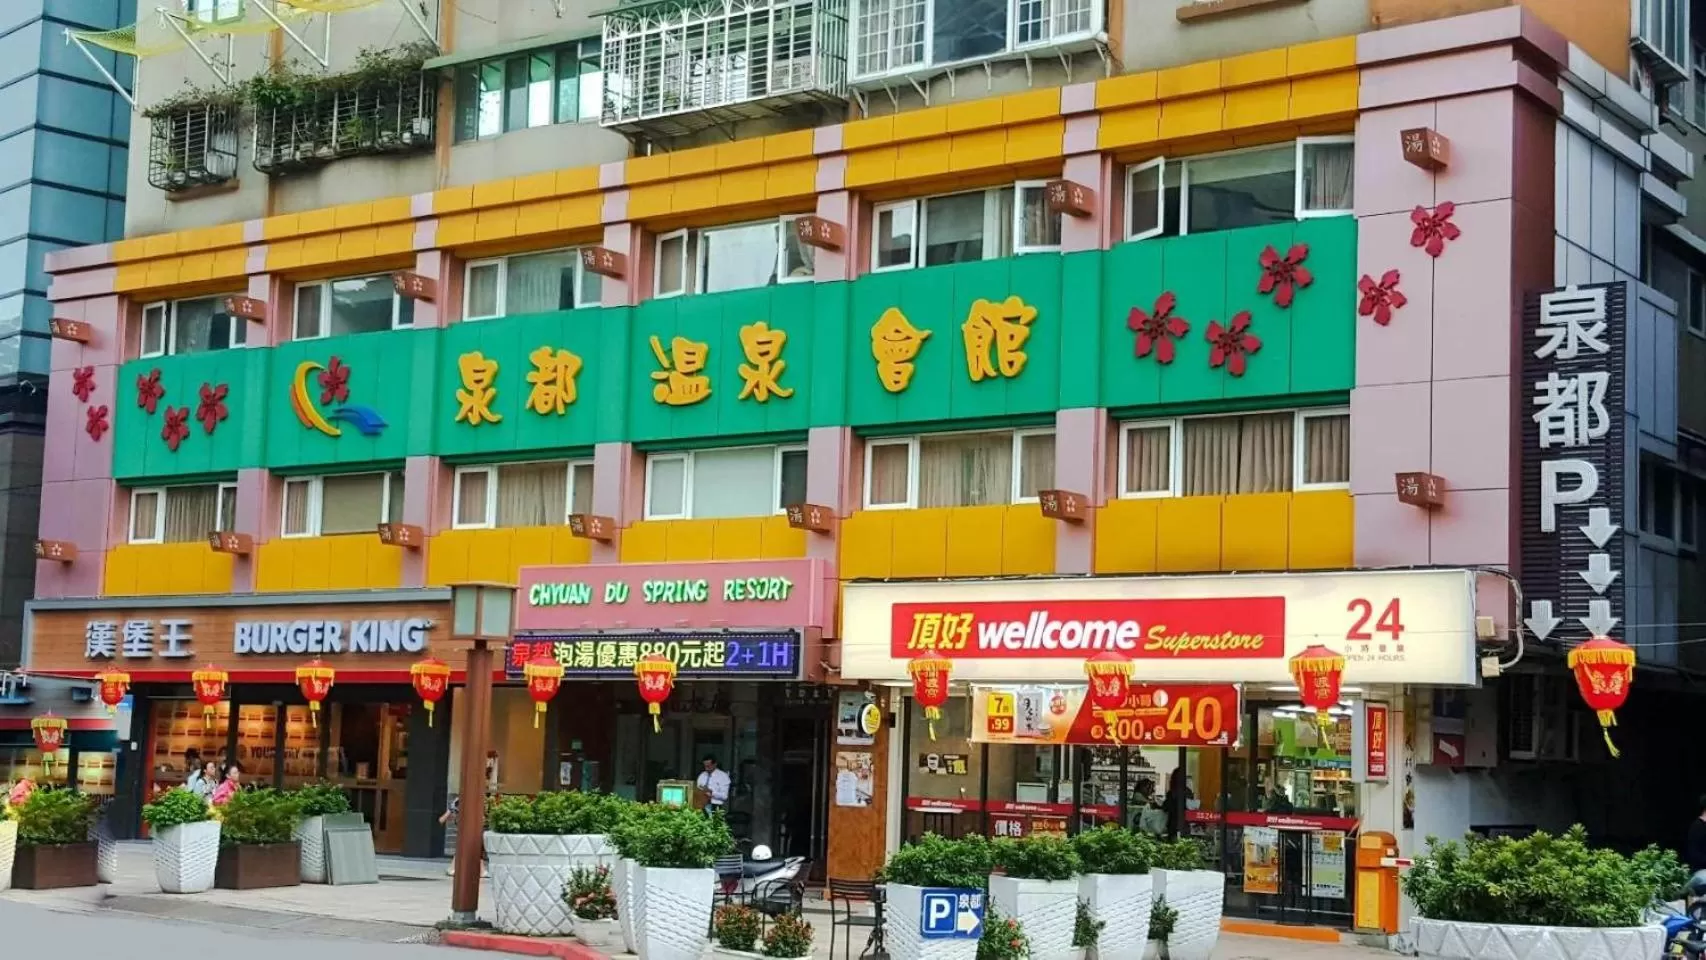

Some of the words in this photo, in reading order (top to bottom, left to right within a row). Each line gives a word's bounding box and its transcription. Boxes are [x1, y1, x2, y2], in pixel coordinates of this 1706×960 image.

[1406, 133, 1424, 153] 湯
[1051, 183, 1066, 203] 湯
[799, 218, 814, 237] 湯
[583, 250, 596, 265] 湯
[1400, 477, 1420, 496] 湯
[1043, 492, 1058, 512] 湯
[571, 517, 584, 533] 湯
[789, 507, 804, 524] 湯
[529, 582, 592, 606] CHYUAN
[604, 580, 629, 604] DU
[643, 578, 709, 604] SPRING
[723, 576, 793, 601] RESORT
[1345, 597, 1405, 641] 24
[84, 619, 195, 659] 漢堡王
[234, 620, 342, 654] BURGER
[350, 618, 426, 653] KING
[907, 612, 975, 651] 頂好
[977, 610, 1141, 652] wellcome
[1144, 624, 1265, 657] Superstore
[1166, 696, 1222, 740] 40
[958, 893, 981, 909] 泉都
[929, 898, 951, 929] P
